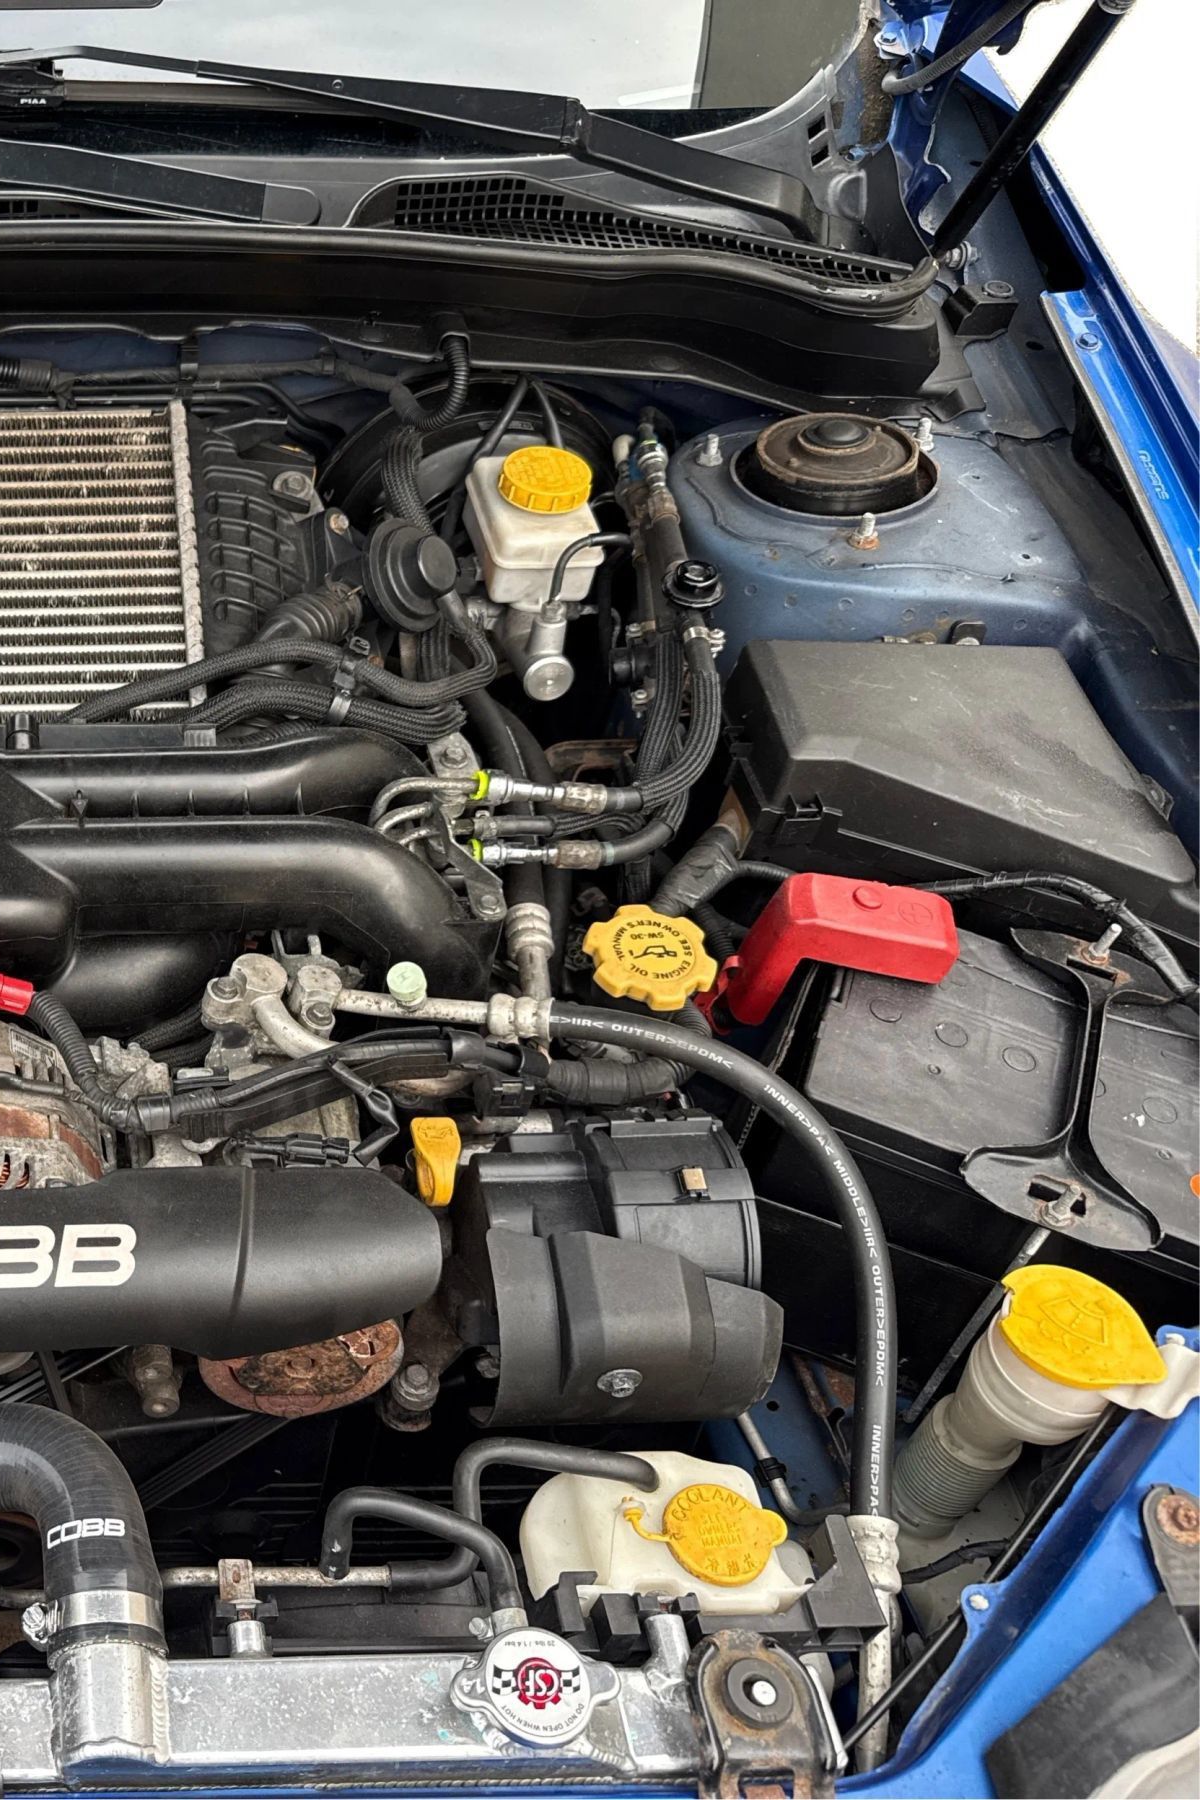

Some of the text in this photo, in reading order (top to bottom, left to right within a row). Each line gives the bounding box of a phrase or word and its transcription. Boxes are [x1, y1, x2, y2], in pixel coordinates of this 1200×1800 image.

[612, 927, 628, 961] MANUAL
[630, 932, 664, 941] 5W-30
[678, 939, 693, 957] SEE
[630, 960, 691, 979] ENGINE OIL
[671, 1487, 747, 1521] COOLANT
[47, 1518, 126, 1549] COBB
[525, 1669, 559, 1697] CSF
[501, 1703, 585, 1732] DO NOT OPEN WHEN HOT
